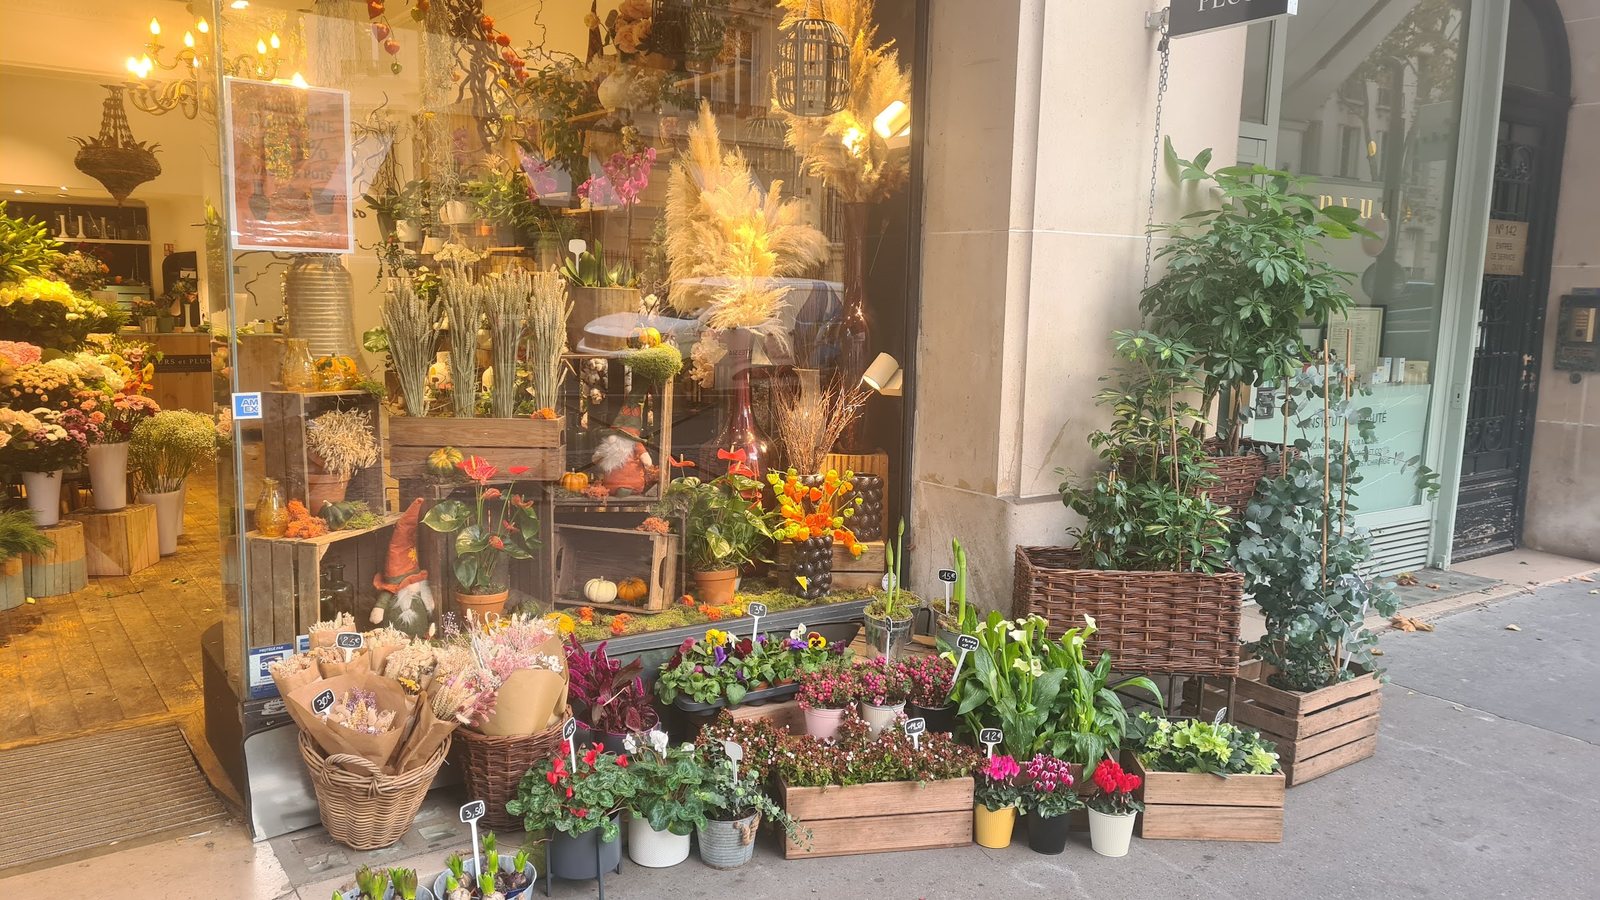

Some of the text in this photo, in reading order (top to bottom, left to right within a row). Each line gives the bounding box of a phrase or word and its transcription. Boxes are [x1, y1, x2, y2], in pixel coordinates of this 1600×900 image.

[1197, 0, 1253, 14] PL
[189, 358, 211, 366] PLUS
[242, 398, 259, 406] AM
[244, 405, 259, 413] EX
